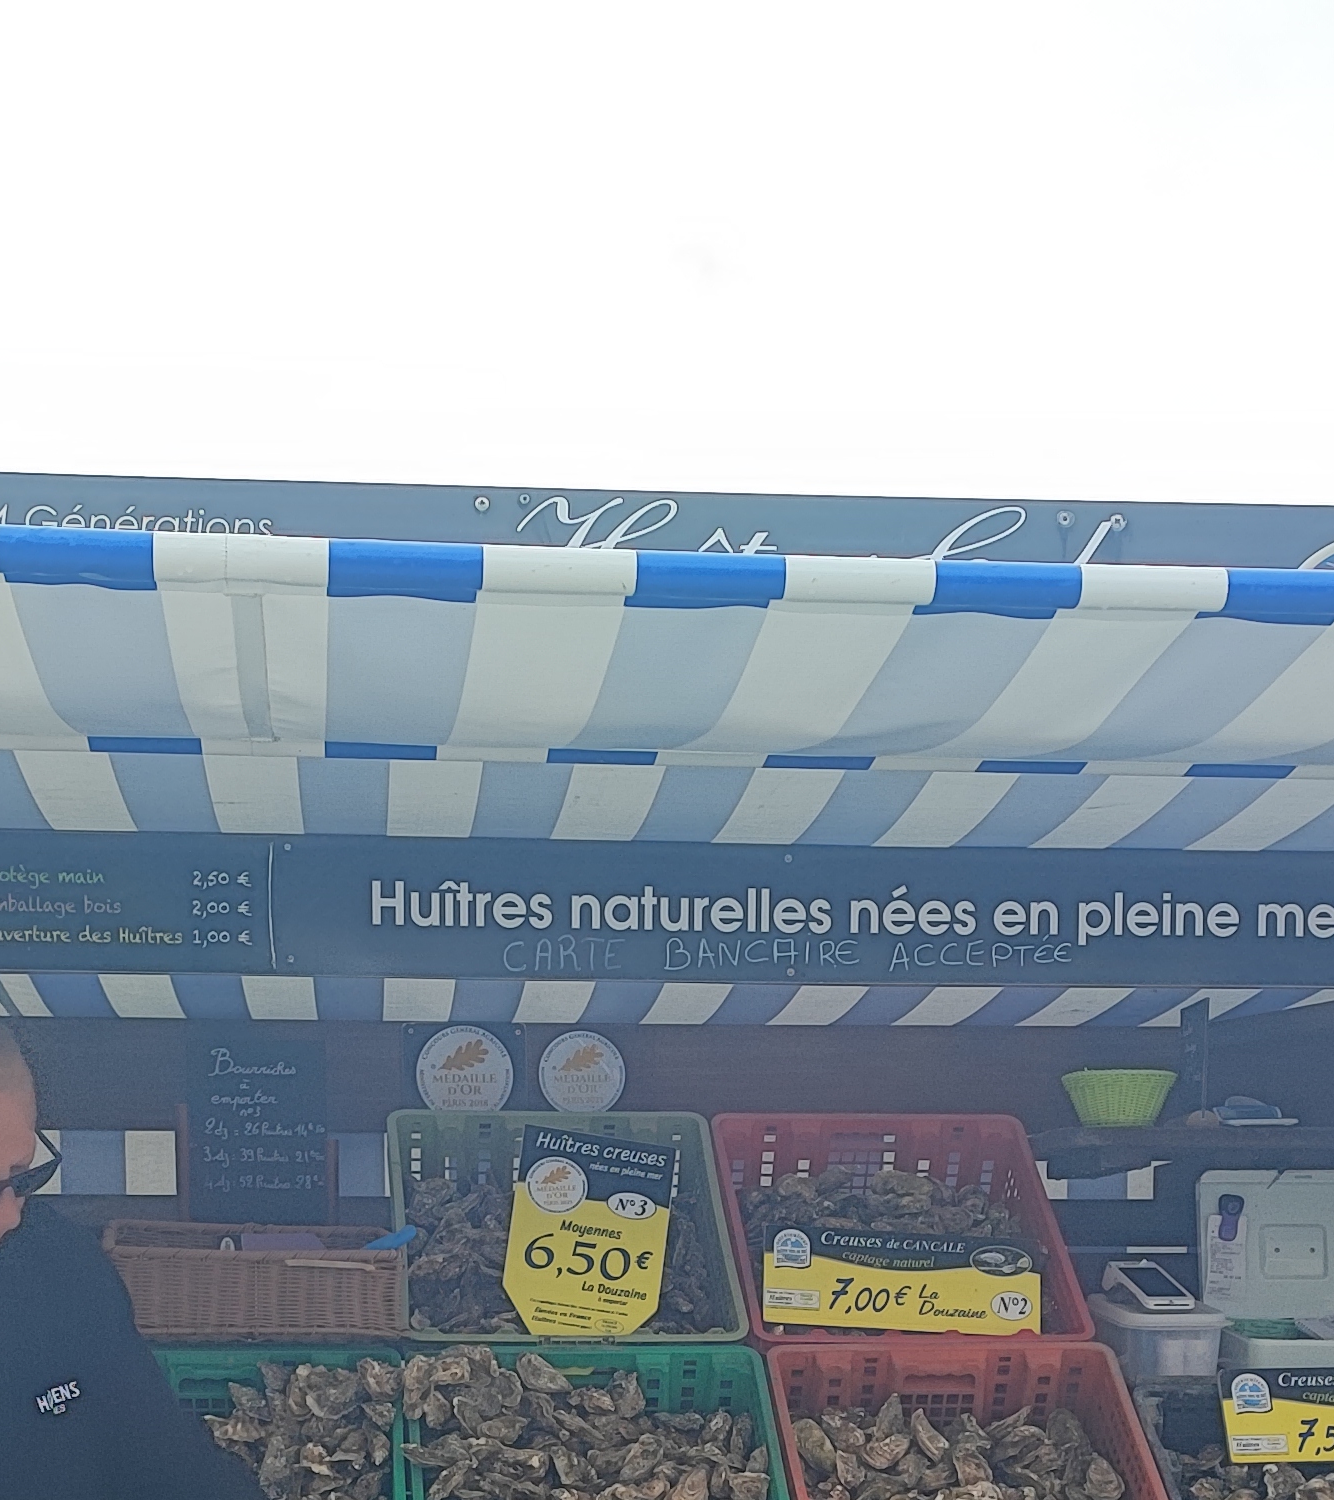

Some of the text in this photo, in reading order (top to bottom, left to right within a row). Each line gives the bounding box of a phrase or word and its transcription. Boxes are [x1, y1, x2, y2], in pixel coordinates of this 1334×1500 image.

[57, 870, 105, 885] main
[192, 871, 230, 889] 2,50
[84, 897, 121, 914] bois
[192, 901, 230, 918] 2,00
[371, 881, 552, 932] Huîtres
[570, 884, 833, 937] naturelles
[849, 885, 977, 937] nées
[994, 900, 1060, 938] en
[1078, 890, 1240, 946] pleine
[78, 926, 112, 944] des
[119, 926, 183, 945] Huîtres
[192, 930, 230, 947] 1,00
[503, 935, 623, 972] CARTE
[208, 1048, 297, 1076] Bourriches
[535, 1131, 667, 1167] Huîtres creuses
[560, 1219, 622, 1240] Moyennes
[820, 1230, 966, 1254] Creuses de CANCALE
[842, 1250, 934, 1268] captage naturel
[582, 1281, 647, 1301] La Douzaine
[919, 1283, 939, 1300] La
[919, 1302, 988, 1319] Douzaine
